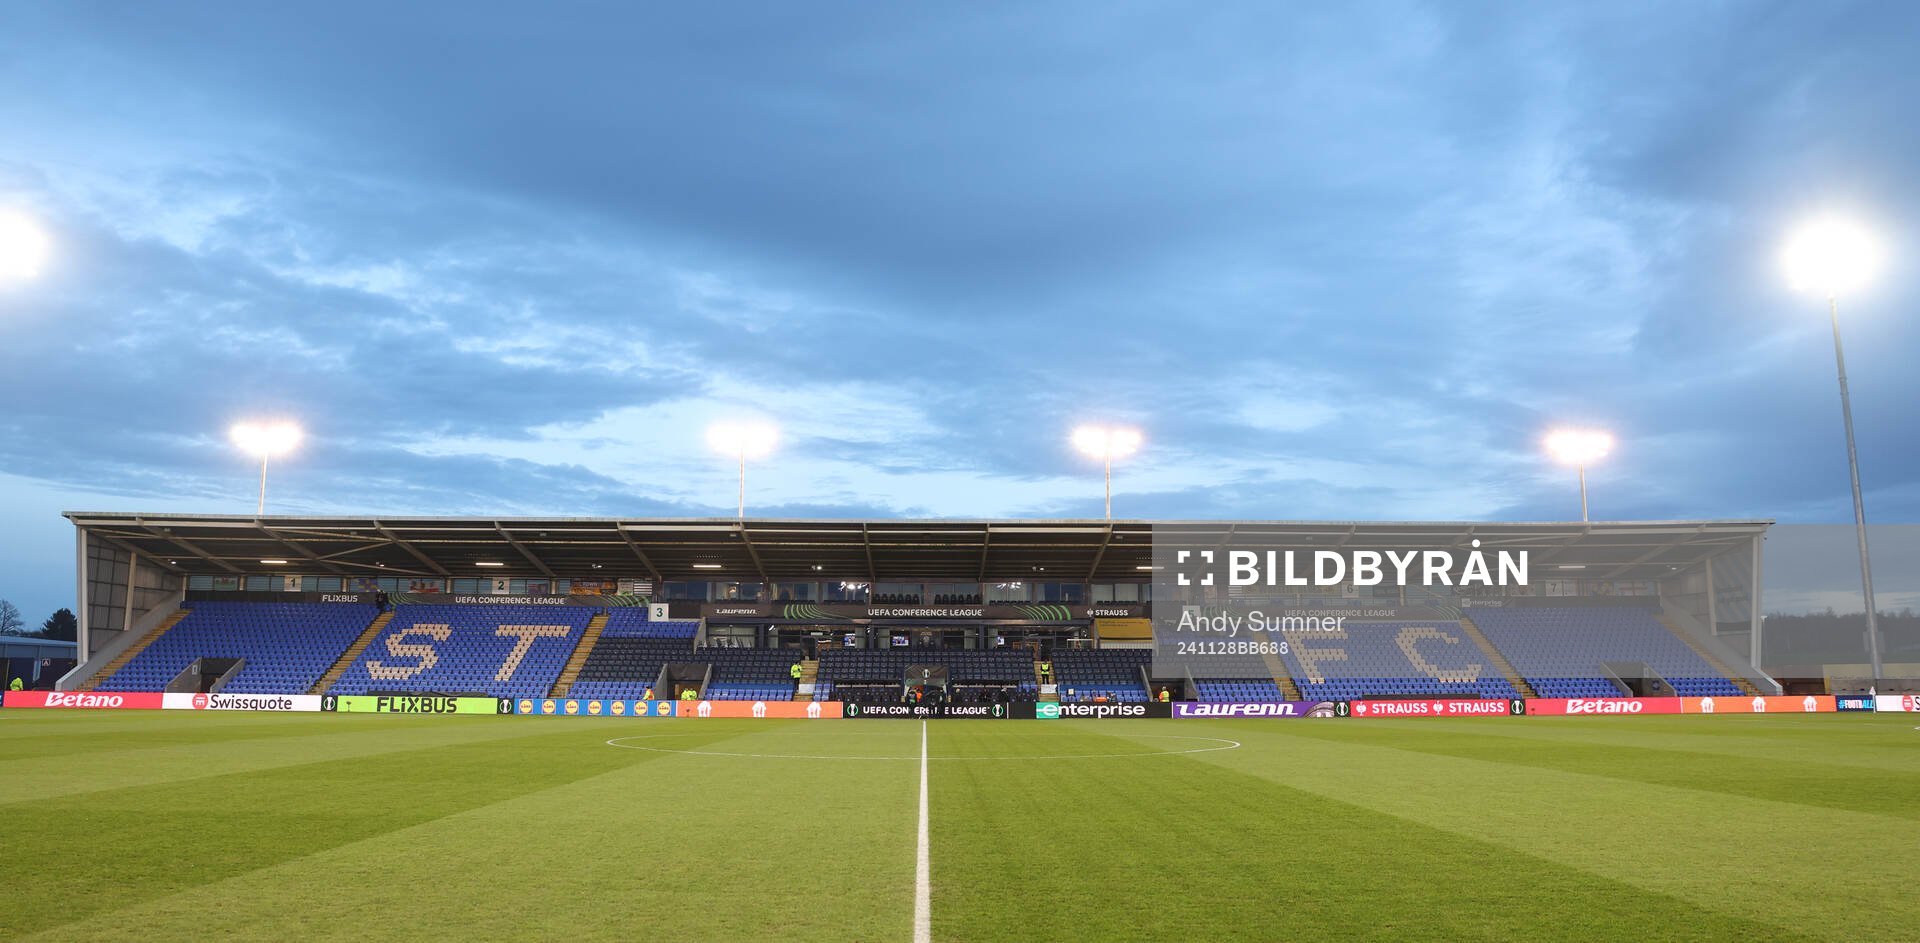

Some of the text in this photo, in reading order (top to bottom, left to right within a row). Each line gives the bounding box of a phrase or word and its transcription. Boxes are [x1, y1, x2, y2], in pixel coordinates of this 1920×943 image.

[498, 580, 505, 591] 2
[455, 596, 565, 606] UEFA CONFERENCE LEAGUE
[656, 607, 663, 618] 3
[867, 608, 983, 617] UEFA CONFERENCE LEAGUE
[1284, 609, 1396, 618] UEFA CONFERENCE LEAGUE
[44, 692, 123, 707] Betano
[210, 694, 293, 711] Swissquote
[863, 706, 887, 715] UEFA
[951, 706, 987, 715] LEAGUE
[1037, 703, 1146, 718] enterprise
[1372, 702, 1504, 714] STRAUSS STRAUSS
[1566, 699, 1643, 713] Betano
